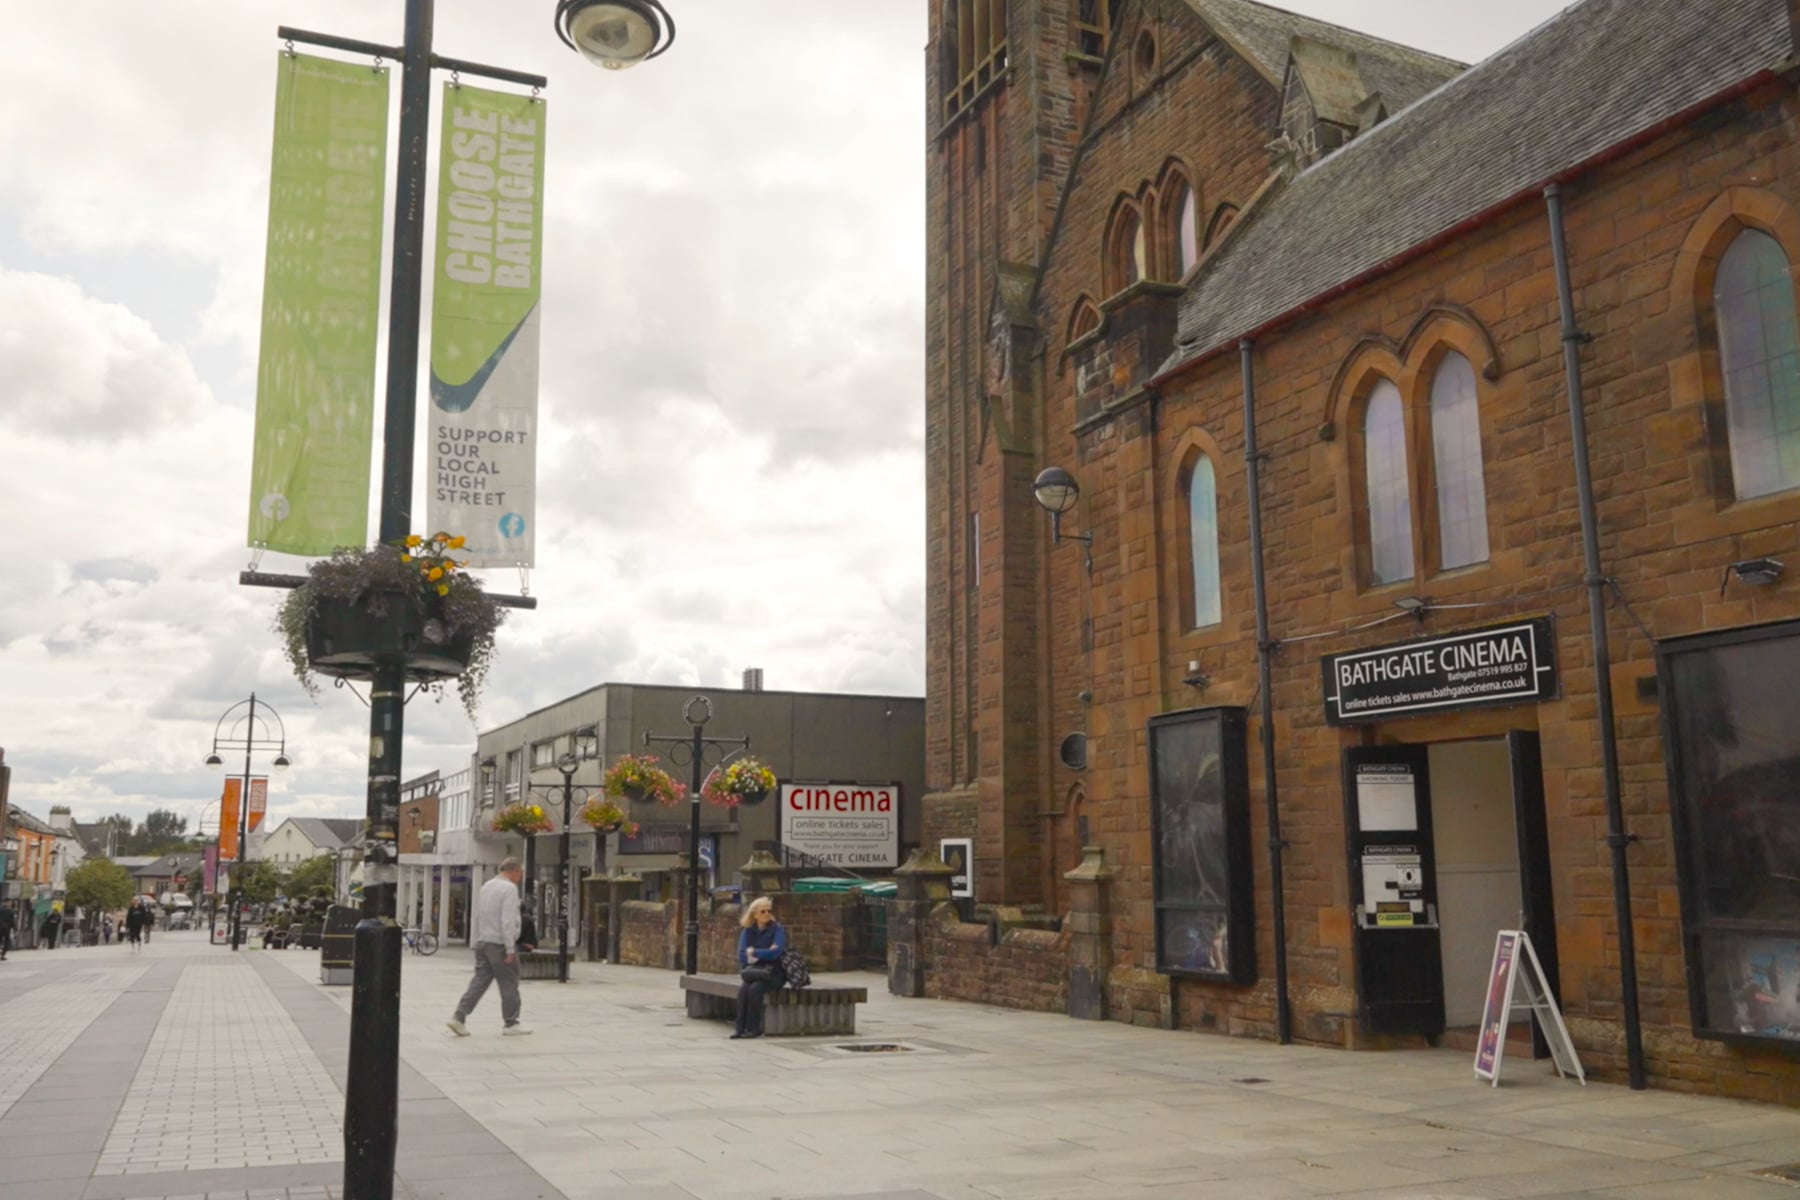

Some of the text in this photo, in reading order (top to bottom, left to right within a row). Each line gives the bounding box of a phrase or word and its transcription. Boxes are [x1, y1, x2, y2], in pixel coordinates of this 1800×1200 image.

[445, 107, 498, 284] CHOOSE
[495, 113, 537, 289] BATHGATE
[437, 426, 528, 445] SUPPORT
[438, 441, 480, 459] OUR
[438, 457, 501, 475] LOCAL
[438, 471, 486, 489] HIGH
[437, 488, 506, 506] STREET
[1341, 636, 1528, 687] BATHGATE CINEMA
[1447, 670, 1477, 681] Bathgate
[1477, 665, 1499, 677] 07519
[1513, 662, 1528, 672] 827
[1345, 676, 1527, 709] online tickets sales www.bathgatecinema.co.uk
[790, 788, 891, 812] cinema
[796, 820, 884, 829] online tickets sales
[848, 853, 888, 862] CINEMA
